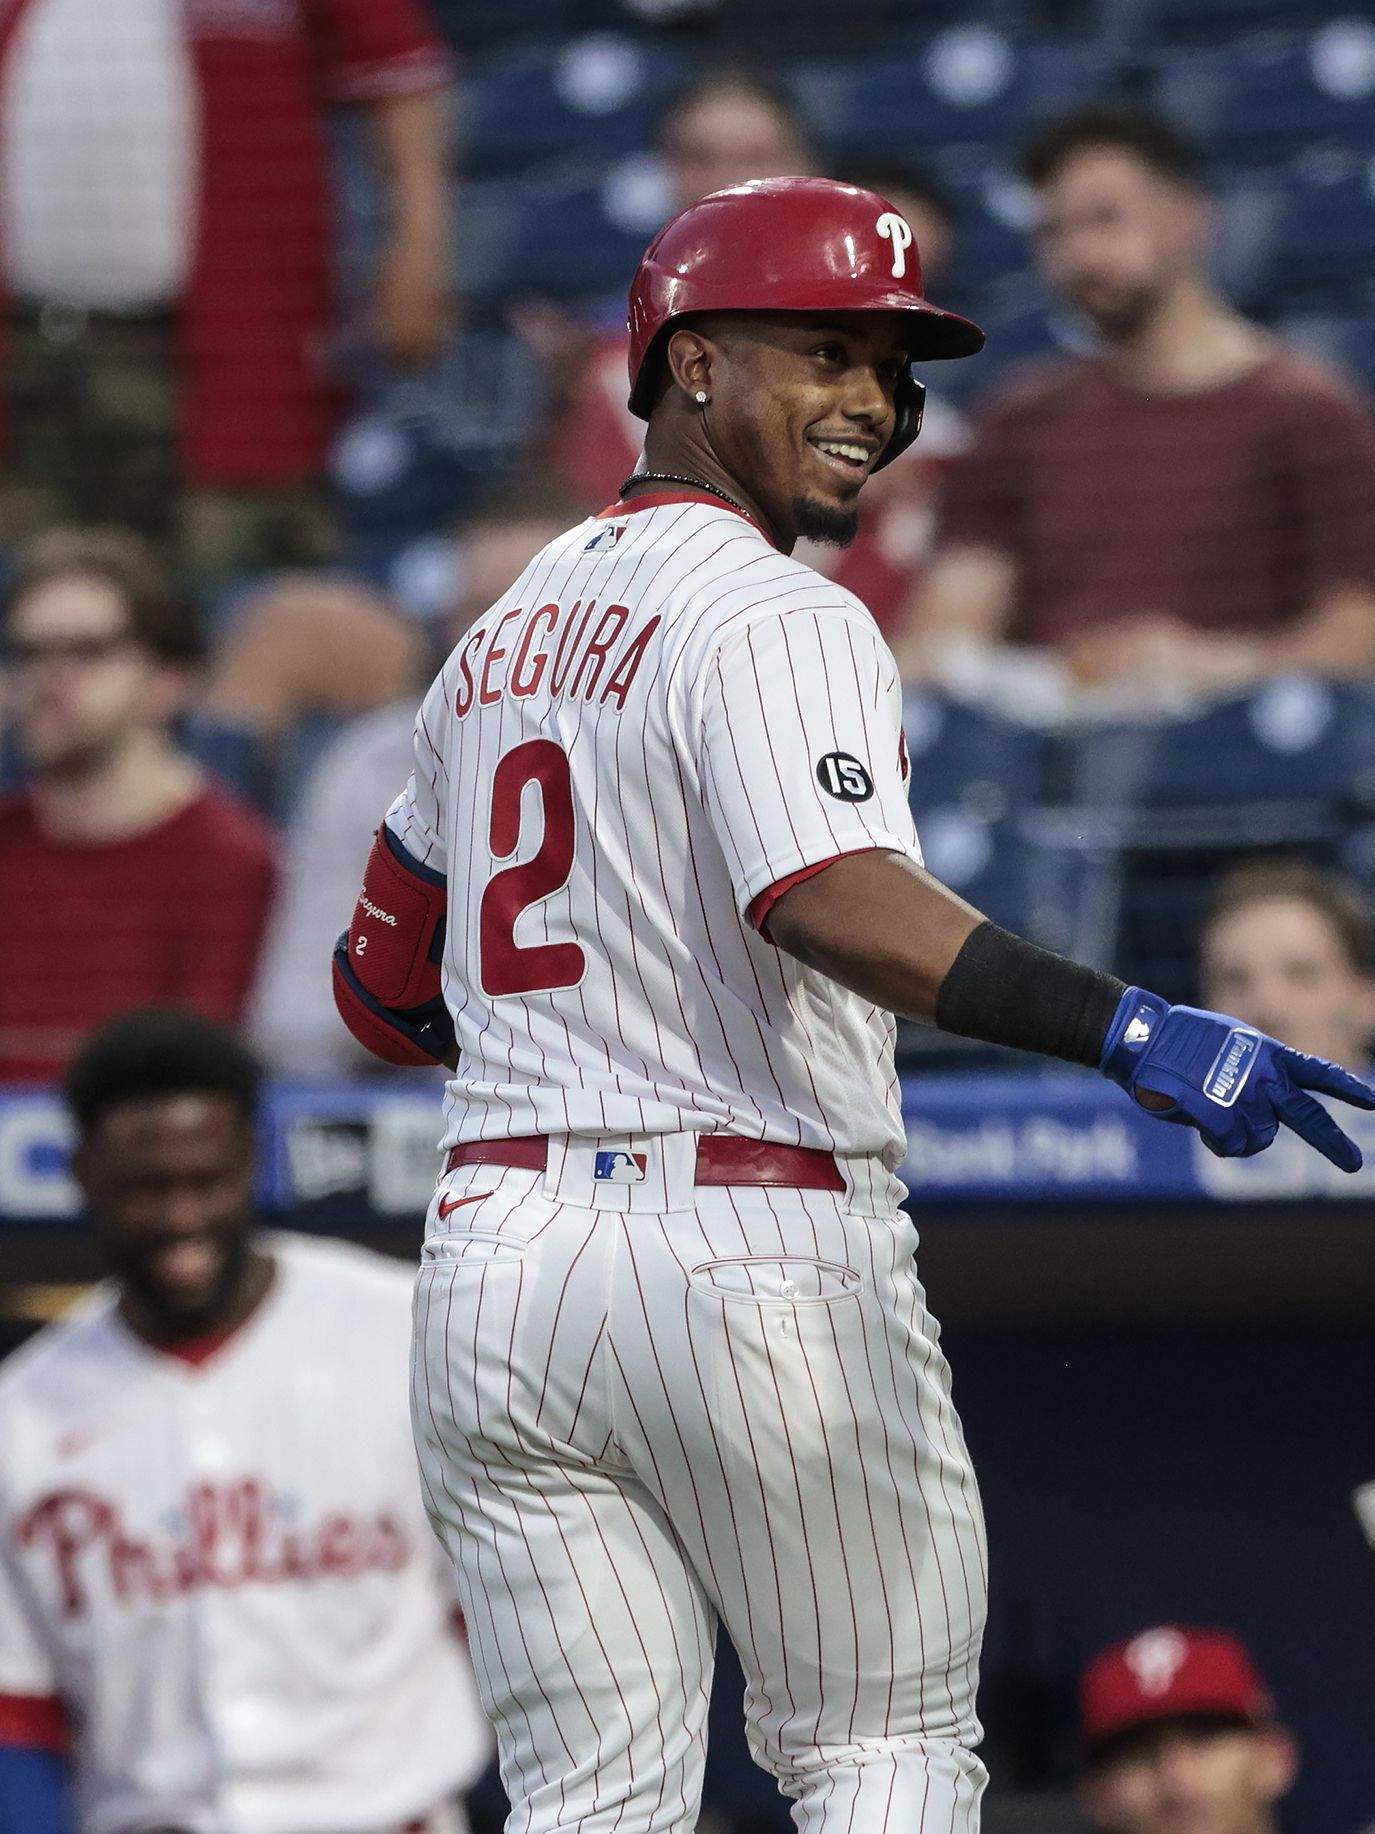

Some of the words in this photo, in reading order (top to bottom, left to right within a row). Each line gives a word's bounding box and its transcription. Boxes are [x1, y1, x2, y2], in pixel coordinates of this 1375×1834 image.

[876, 212, 912, 278] P
[454, 598, 663, 719] SEGURA
[825, 757, 868, 796] 15
[480, 740, 588, 1000] 2
[355, 936, 368, 956] 2
[1211, 1032, 1255, 1098] Franklin
[1017, 1113, 1137, 1182] Park
